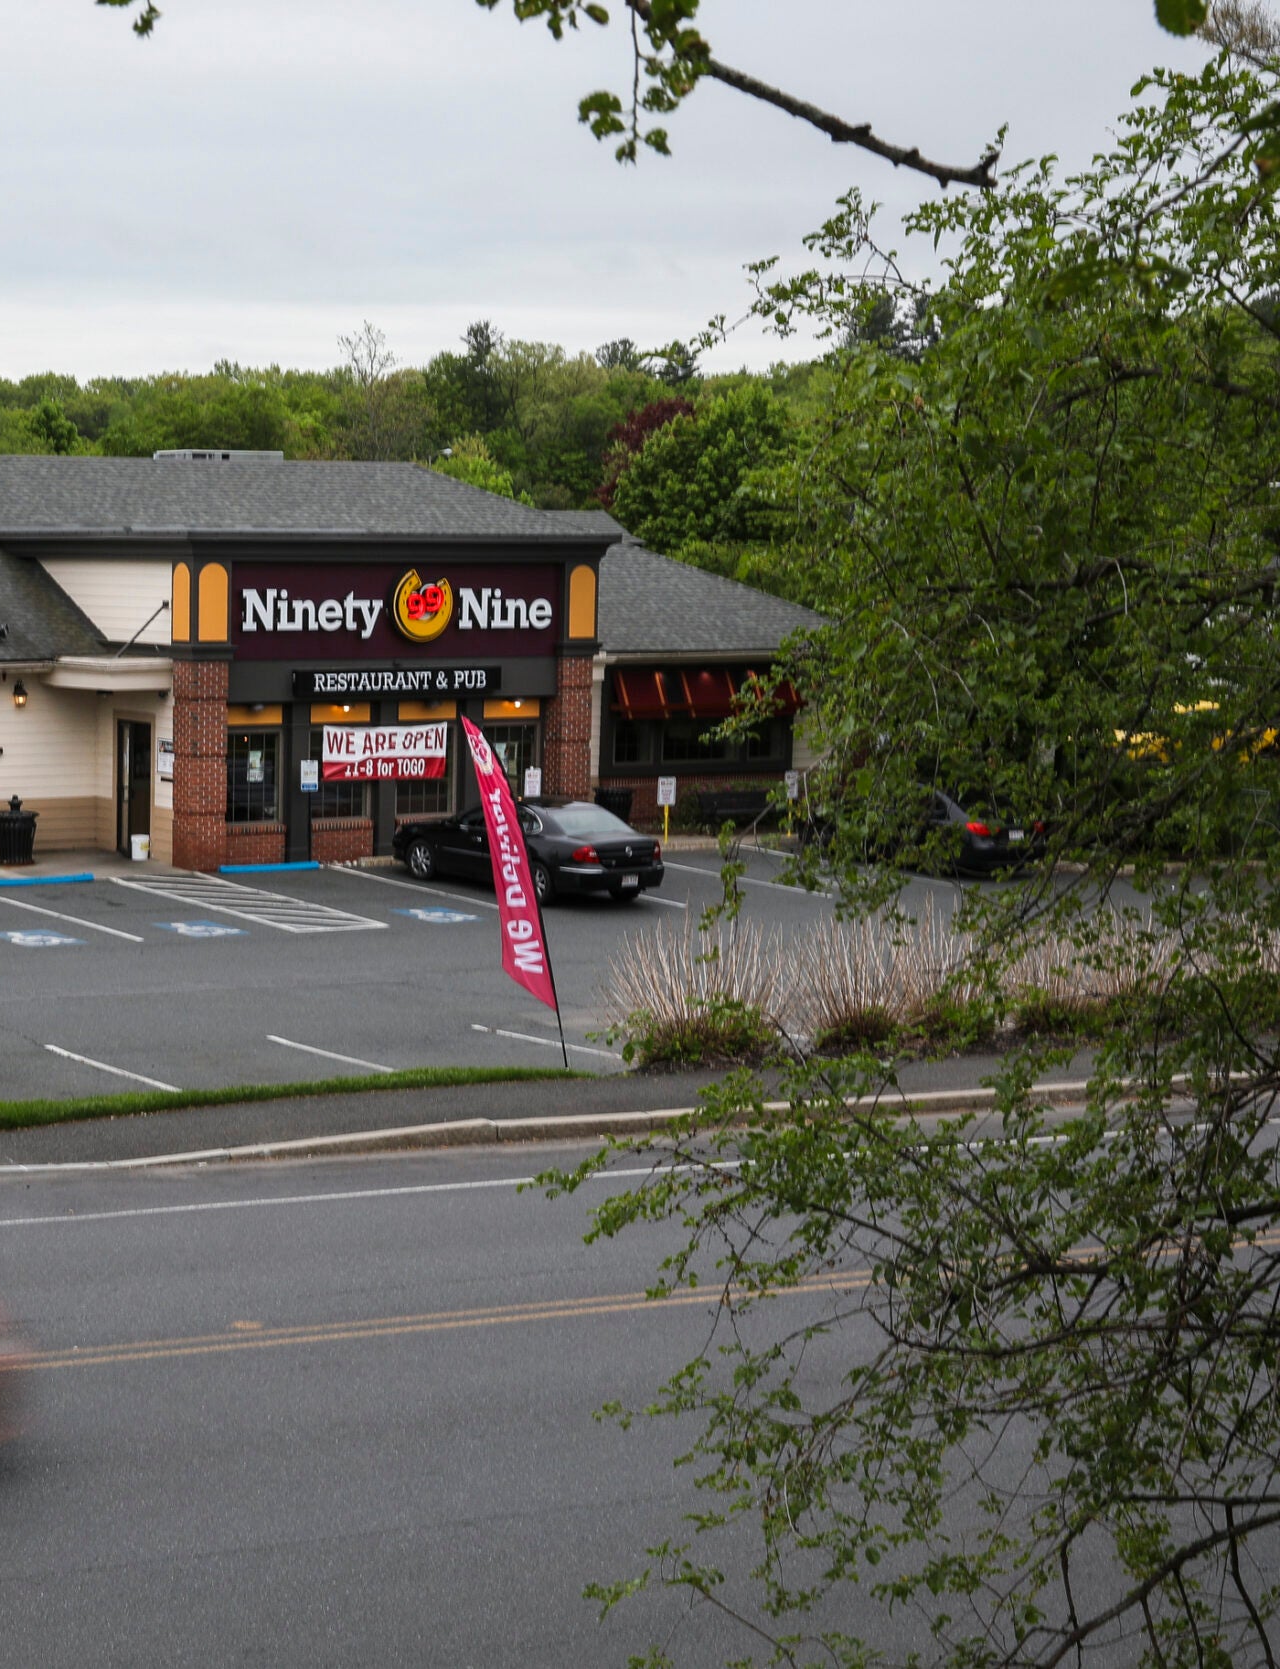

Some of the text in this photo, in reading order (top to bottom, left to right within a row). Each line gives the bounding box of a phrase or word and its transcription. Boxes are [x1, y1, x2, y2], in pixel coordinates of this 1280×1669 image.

[242, 586, 552, 639] Ninety 99 Nine
[313, 669, 487, 693] RESTAURANT & PUB
[326, 731, 356, 756] WE
[362, 731, 397, 755] ARE
[402, 727, 445, 751] OPEN
[377, 759, 395, 776] for
[397, 758, 425, 776] TOGO
[507, 919, 543, 975] We
